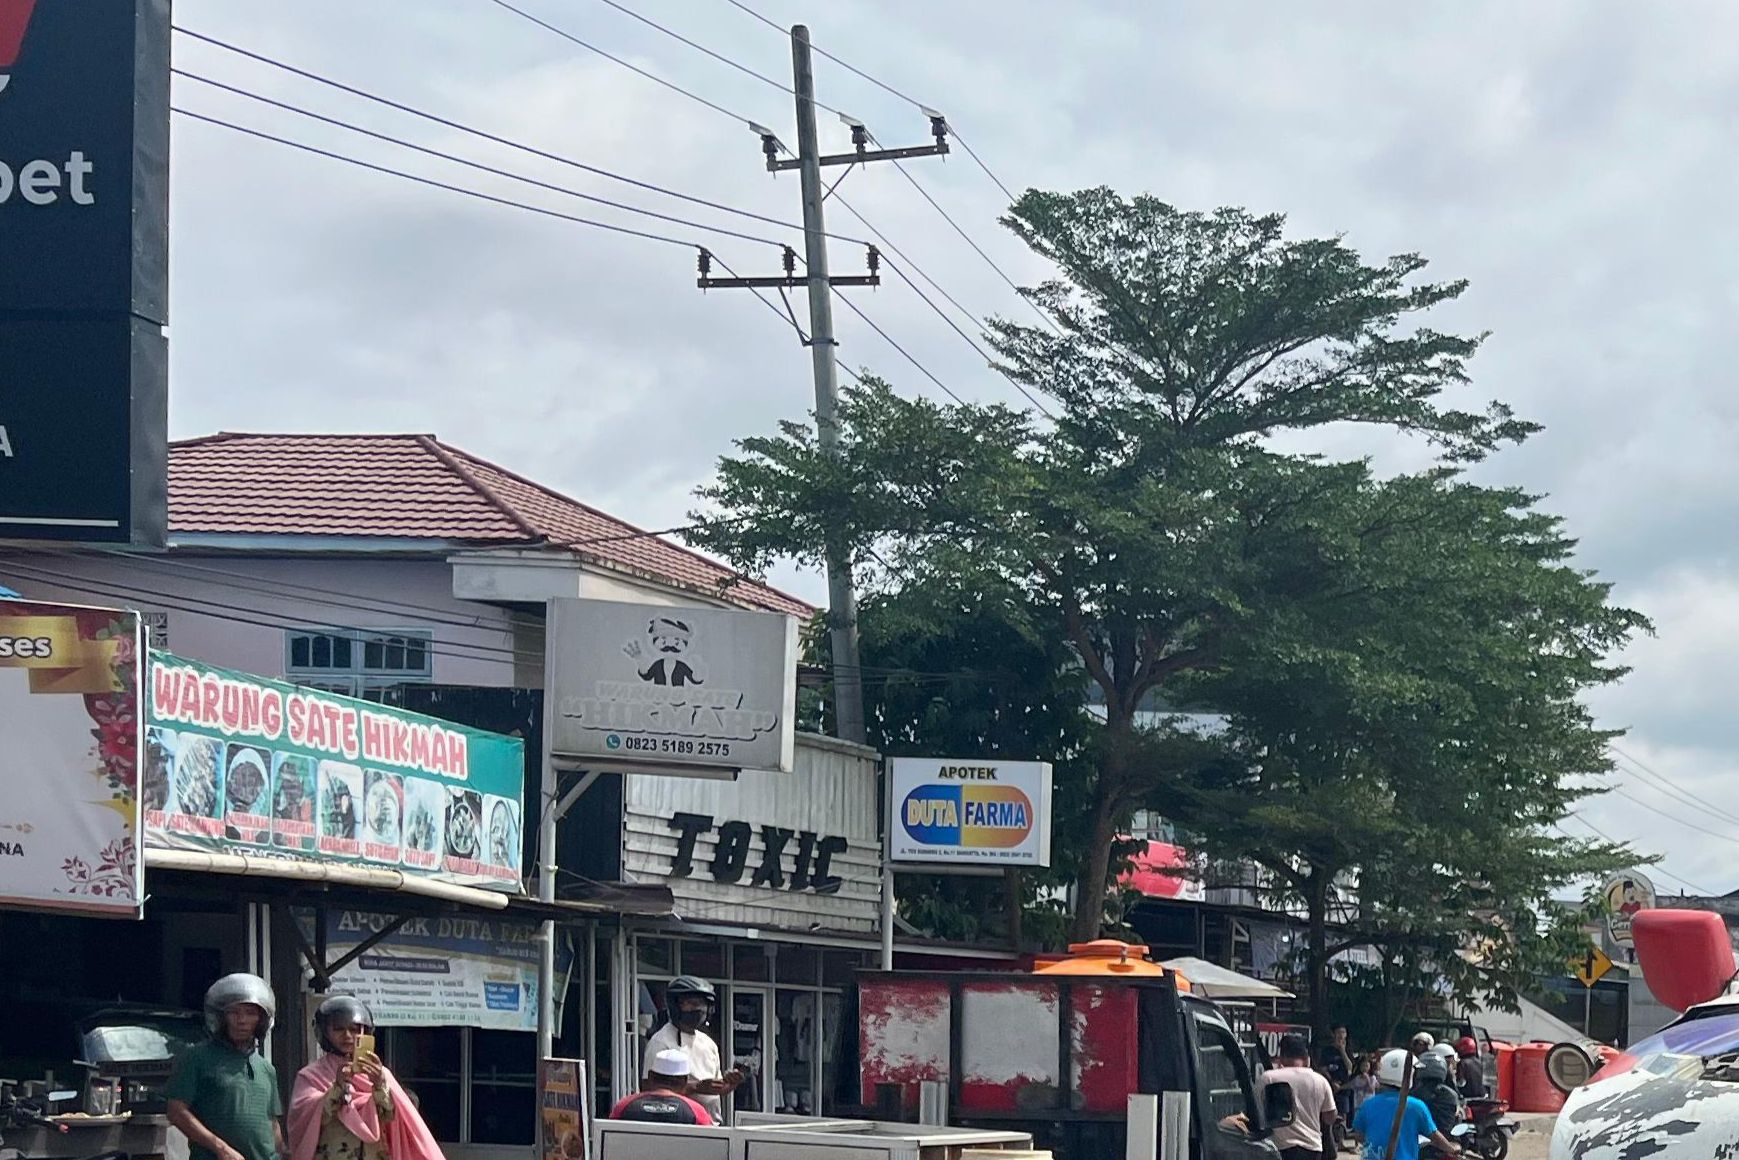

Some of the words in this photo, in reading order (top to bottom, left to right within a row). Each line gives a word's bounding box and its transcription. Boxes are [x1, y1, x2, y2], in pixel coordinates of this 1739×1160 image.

[153, 663, 282, 738] WARUNG
[287, 695, 358, 758] SATE
[361, 711, 467, 779] HIKMAH
[625, 736, 658, 751] 0823
[661, 738, 694, 754] 5189
[697, 741, 730, 757] 2575
[938, 766, 998, 780] APOTEK
[907, 799, 958, 827] DUTA
[965, 801, 1028, 829] FARMA
[668, 811, 848, 894] TOXIC
[437, 917, 493, 942] DUTA
